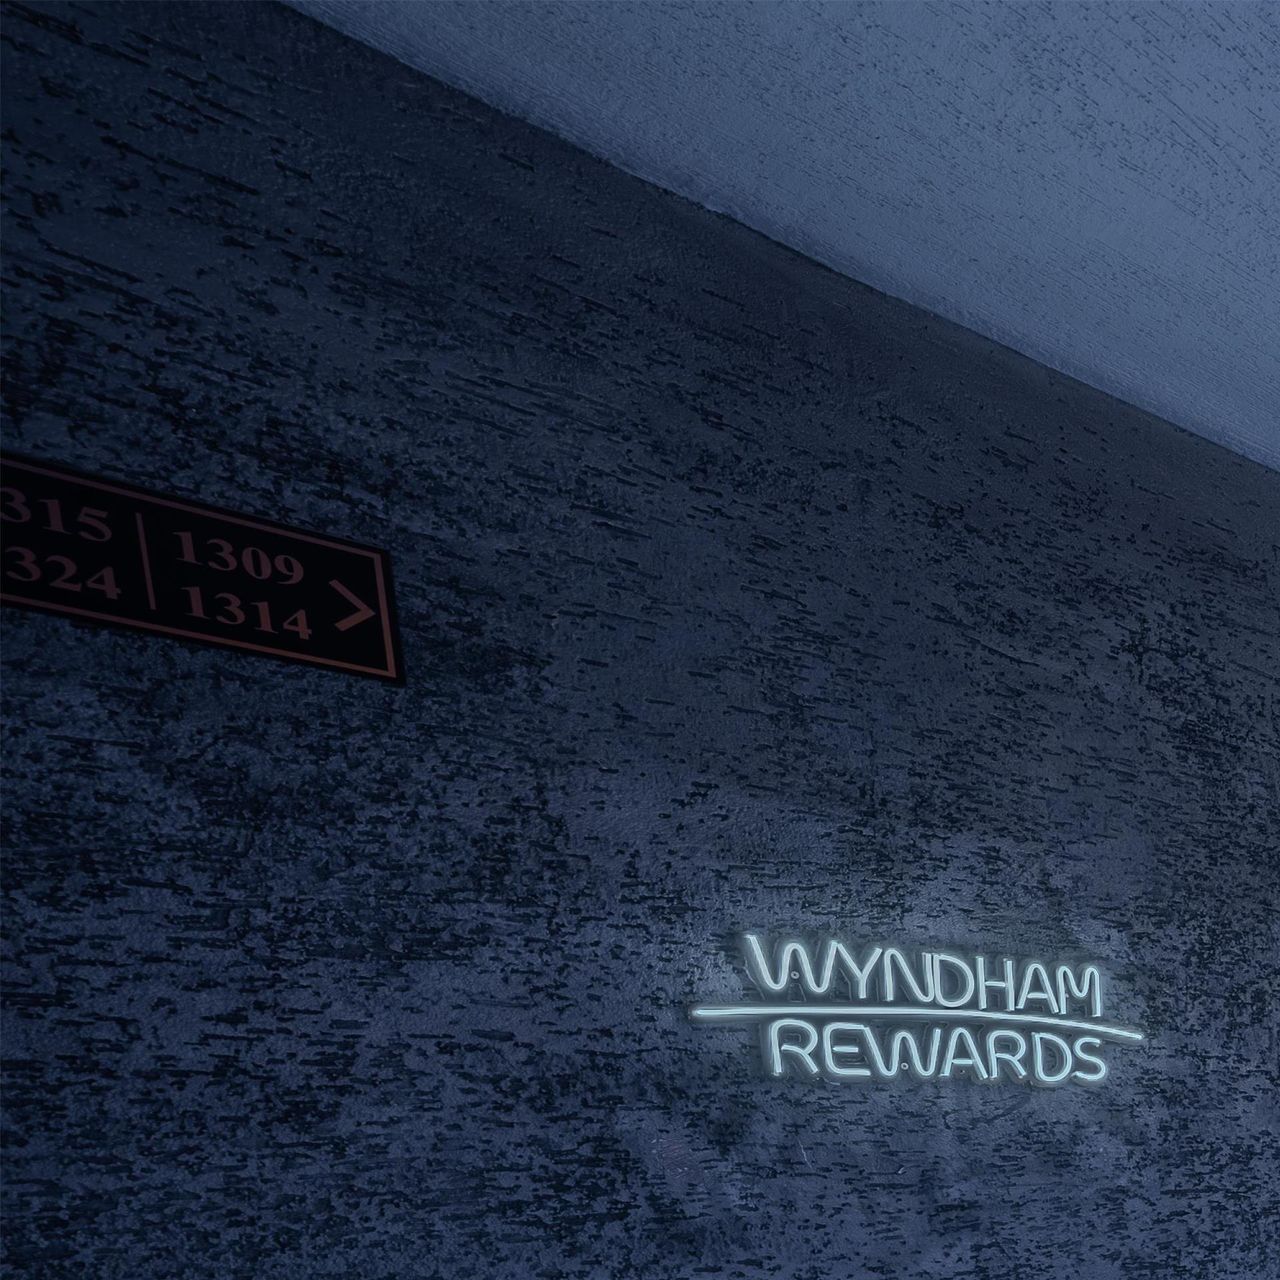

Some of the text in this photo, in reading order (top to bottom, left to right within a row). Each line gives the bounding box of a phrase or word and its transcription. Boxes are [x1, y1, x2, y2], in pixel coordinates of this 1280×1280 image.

[6, 546, 122, 600] 324
[173, 531, 304, 585] 1309
[181, 586, 312, 640] 1314
[744, 934, 1101, 1017] WYNDHAM
[770, 1019, 1107, 1082] REWARDS
